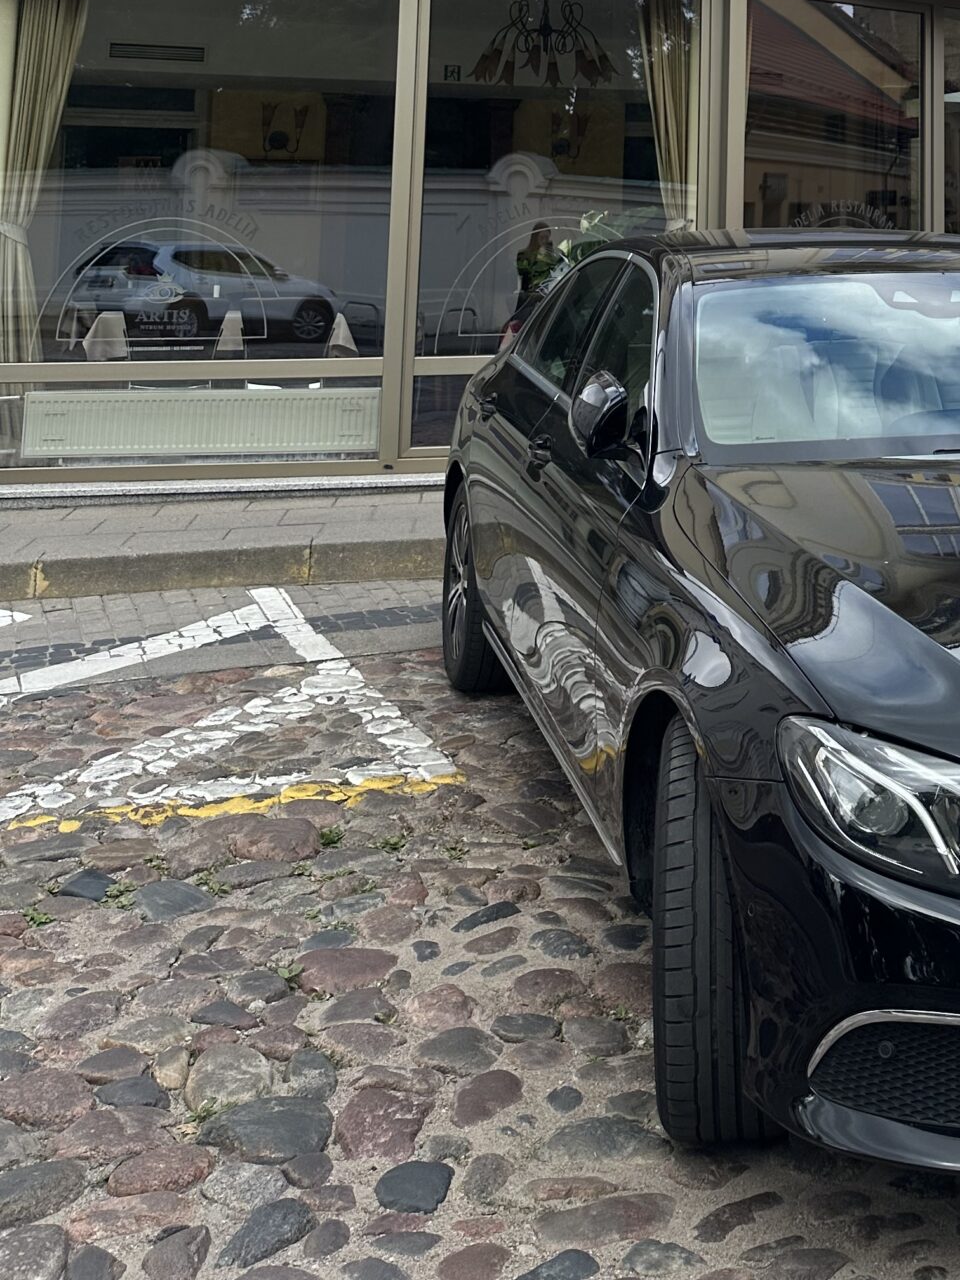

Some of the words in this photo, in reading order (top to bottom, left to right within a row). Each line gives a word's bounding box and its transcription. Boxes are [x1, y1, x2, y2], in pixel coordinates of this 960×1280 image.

[789, 204, 825, 228] DELIA
[831, 199, 898, 230] RESTAURAN
[135, 309, 191, 323] ARTIS
